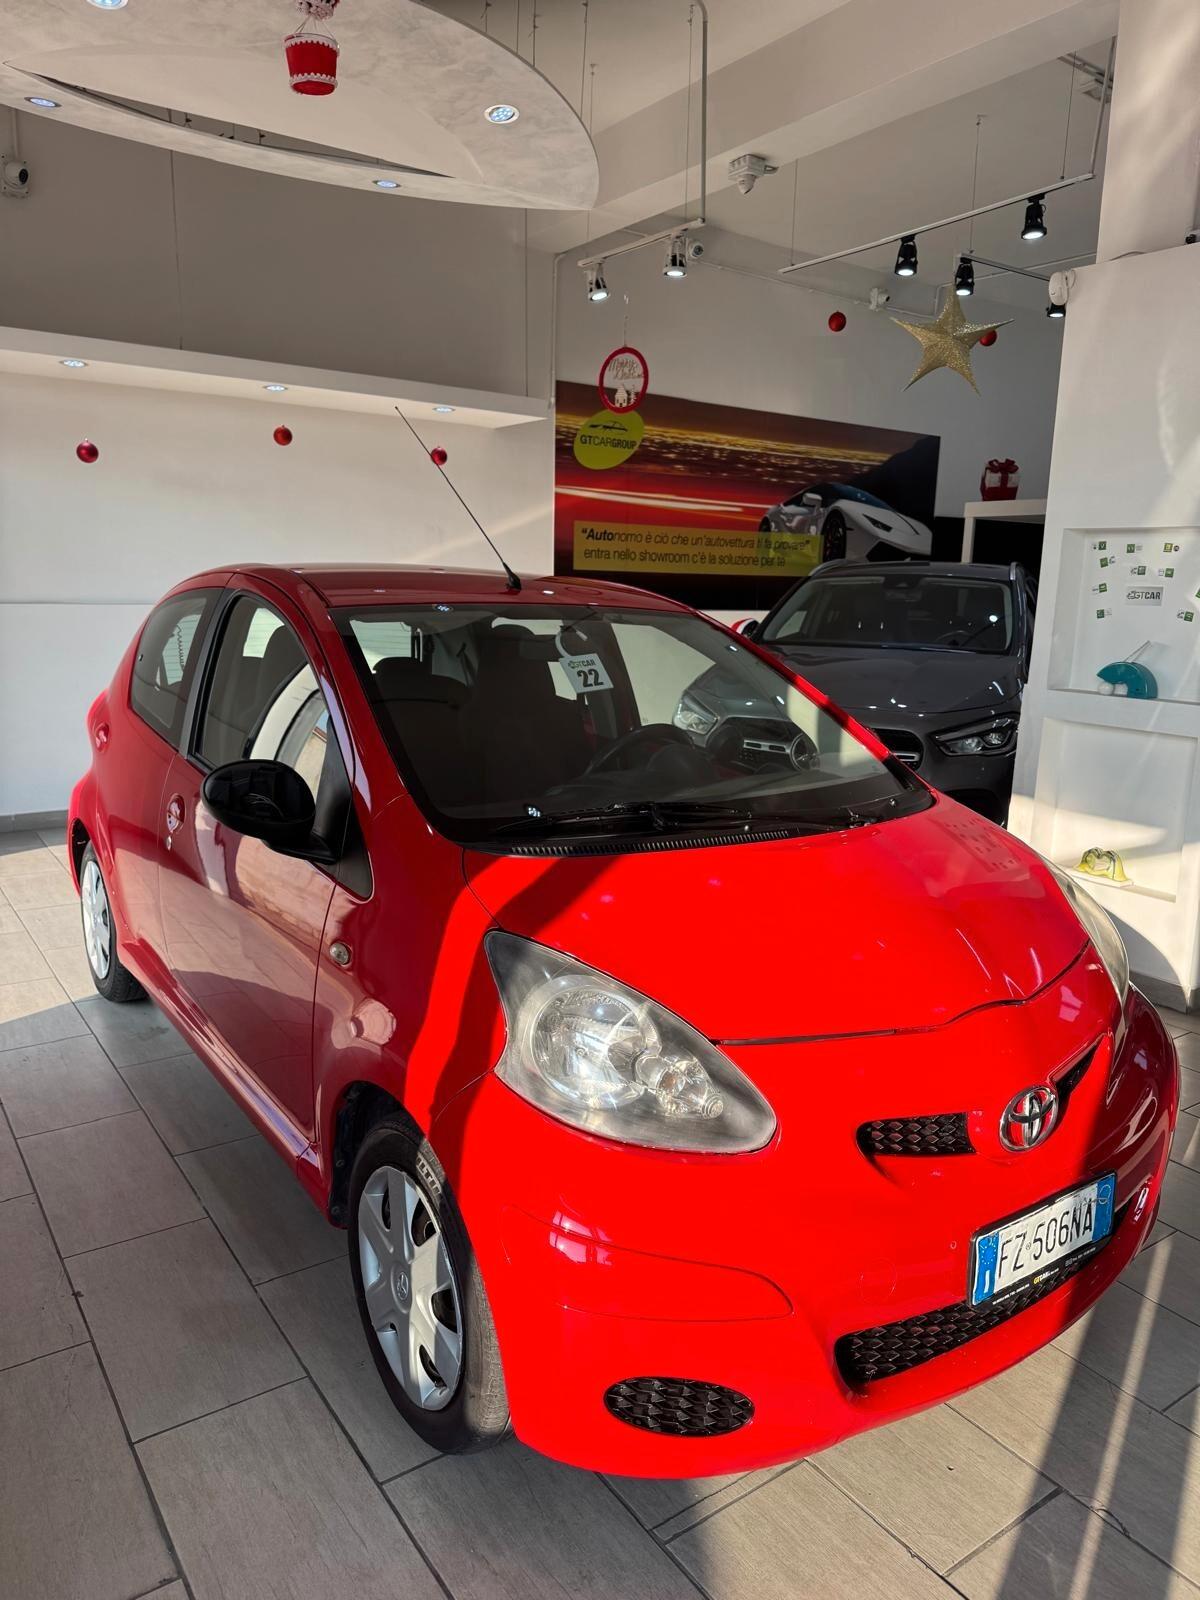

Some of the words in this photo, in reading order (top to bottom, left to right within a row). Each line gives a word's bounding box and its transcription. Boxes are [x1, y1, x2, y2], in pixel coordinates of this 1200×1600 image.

[580, 435, 637, 450] GTCARGROUP
[645, 531, 652, 544] è
[654, 532, 669, 545] ciò
[671, 533, 689, 546] che
[584, 548, 611, 560] entra
[613, 547, 637, 561] nello
[639, 549, 690, 564] showroom
[708, 552, 716, 565] la
[718, 553, 760, 566] soluzione
[760, 556, 775, 568] per
[777, 556, 786, 567] te
[1134, 591, 1161, 600] GTCAR
[576, 668, 604, 688] 22
